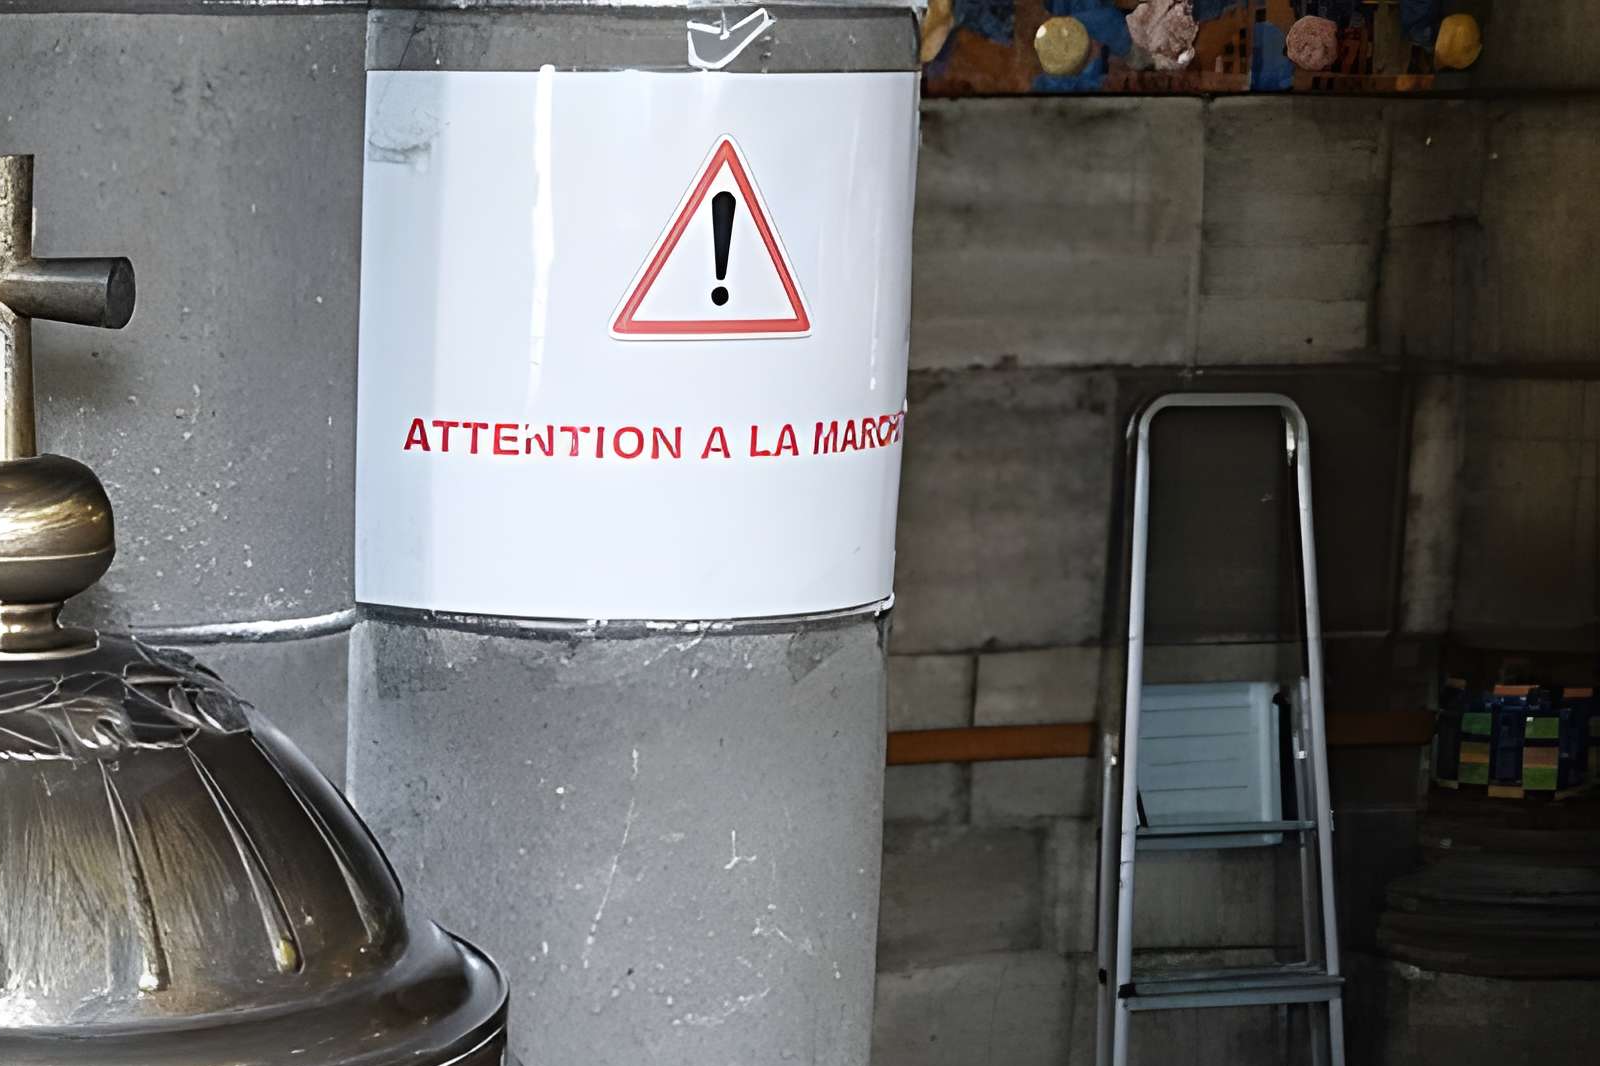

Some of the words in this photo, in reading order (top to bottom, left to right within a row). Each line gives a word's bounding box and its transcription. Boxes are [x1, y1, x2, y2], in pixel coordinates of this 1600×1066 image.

[404, 417, 684, 460] ATTENTION
[700, 425, 731, 460] A
[749, 423, 800, 458] LA
